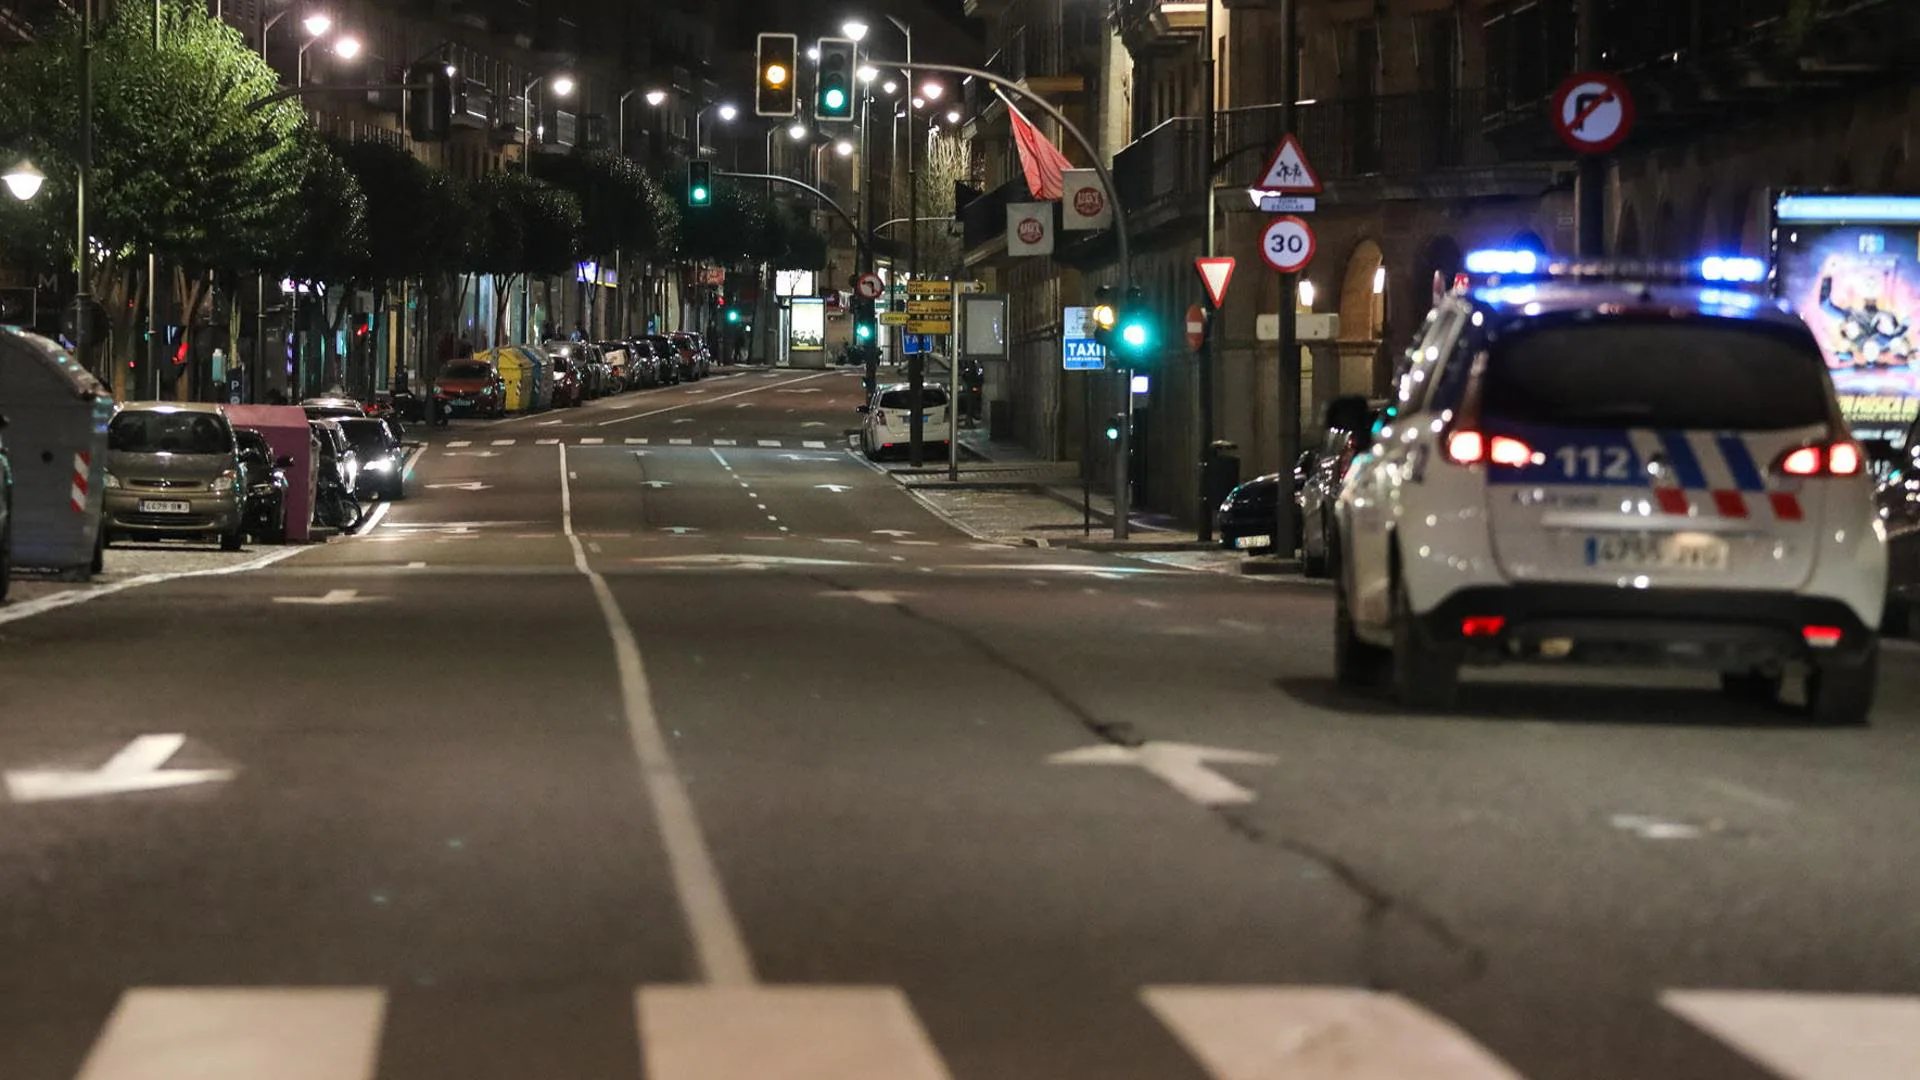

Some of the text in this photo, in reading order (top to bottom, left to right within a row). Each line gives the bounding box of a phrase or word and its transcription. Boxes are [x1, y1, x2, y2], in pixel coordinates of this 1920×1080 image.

[1271, 234, 1303, 253] 30
[1067, 342, 1101, 356] TAXI
[231, 379, 240, 391] P
[1557, 446, 1630, 478] 112
